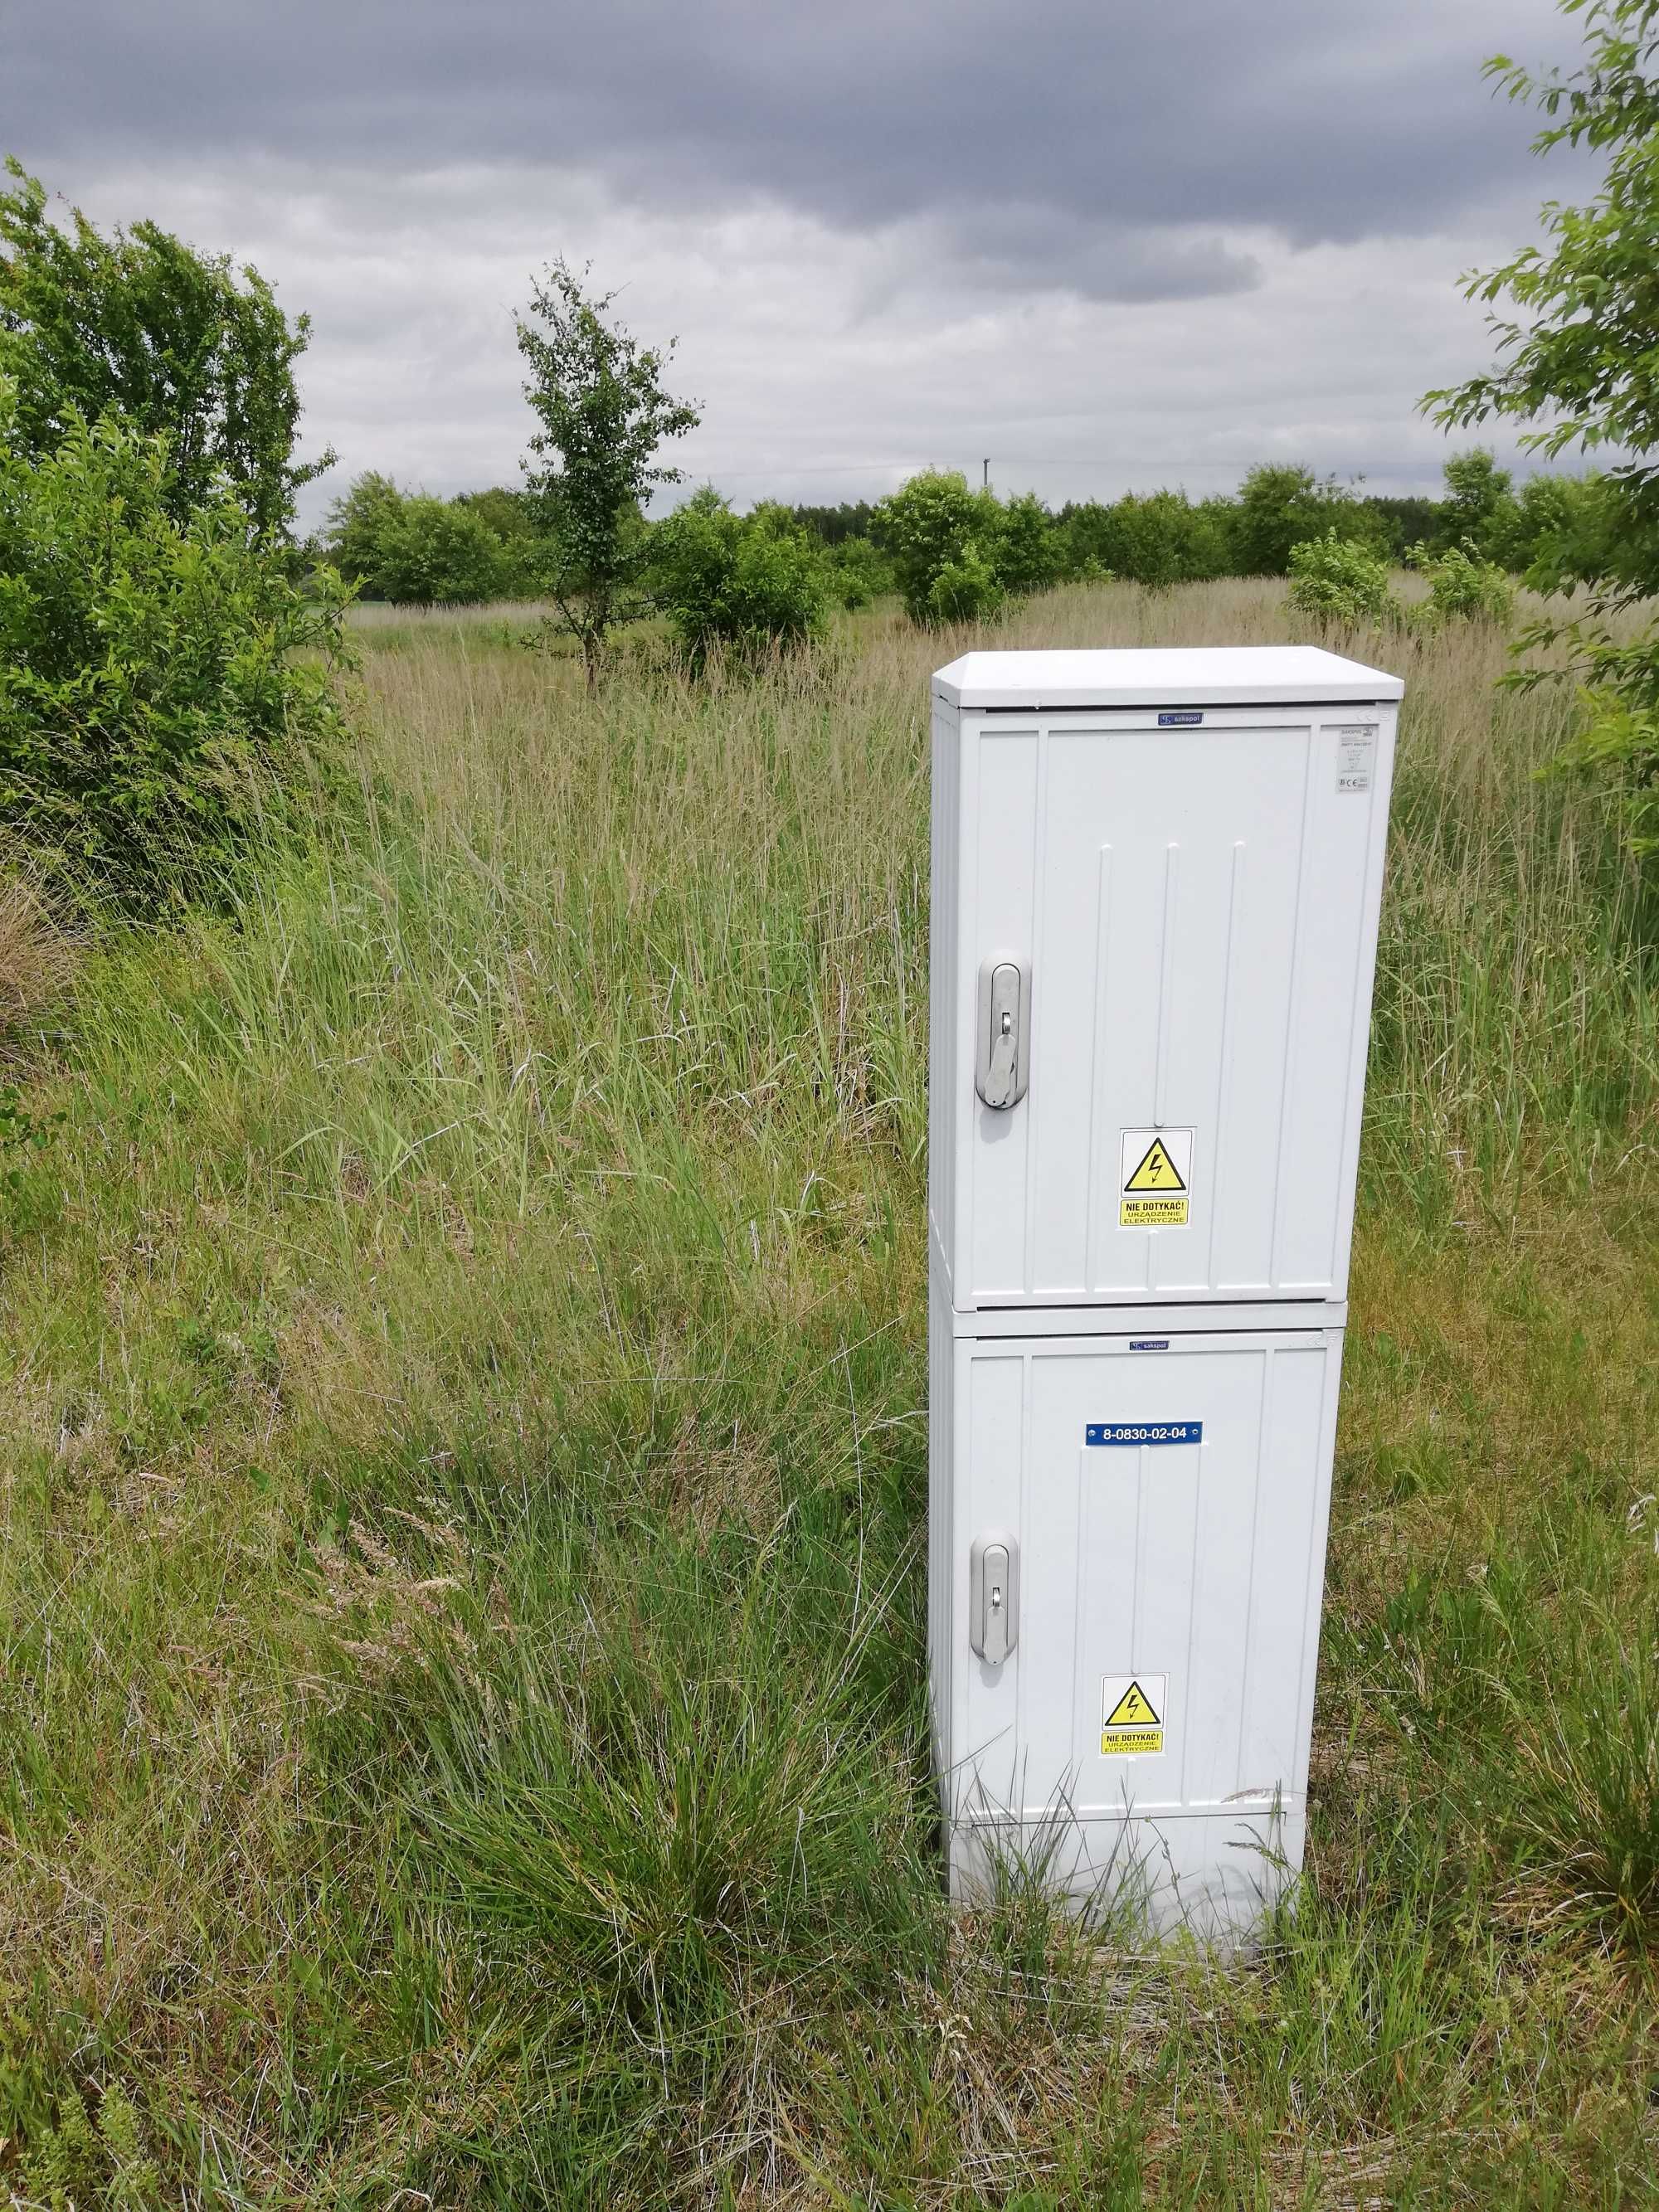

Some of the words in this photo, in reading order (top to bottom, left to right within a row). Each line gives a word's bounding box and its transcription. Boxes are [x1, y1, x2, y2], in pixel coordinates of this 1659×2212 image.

[1126, 1203, 1141, 1211] NIE
[1142, 1200, 1185, 1211] DOTYKAĆ!
[1103, 1427, 1187, 1440] 8-0830-02-04
[1107, 1734, 1120, 1743] NIE
[1121, 1732, 1159, 1742] DOTYKAĆ!
